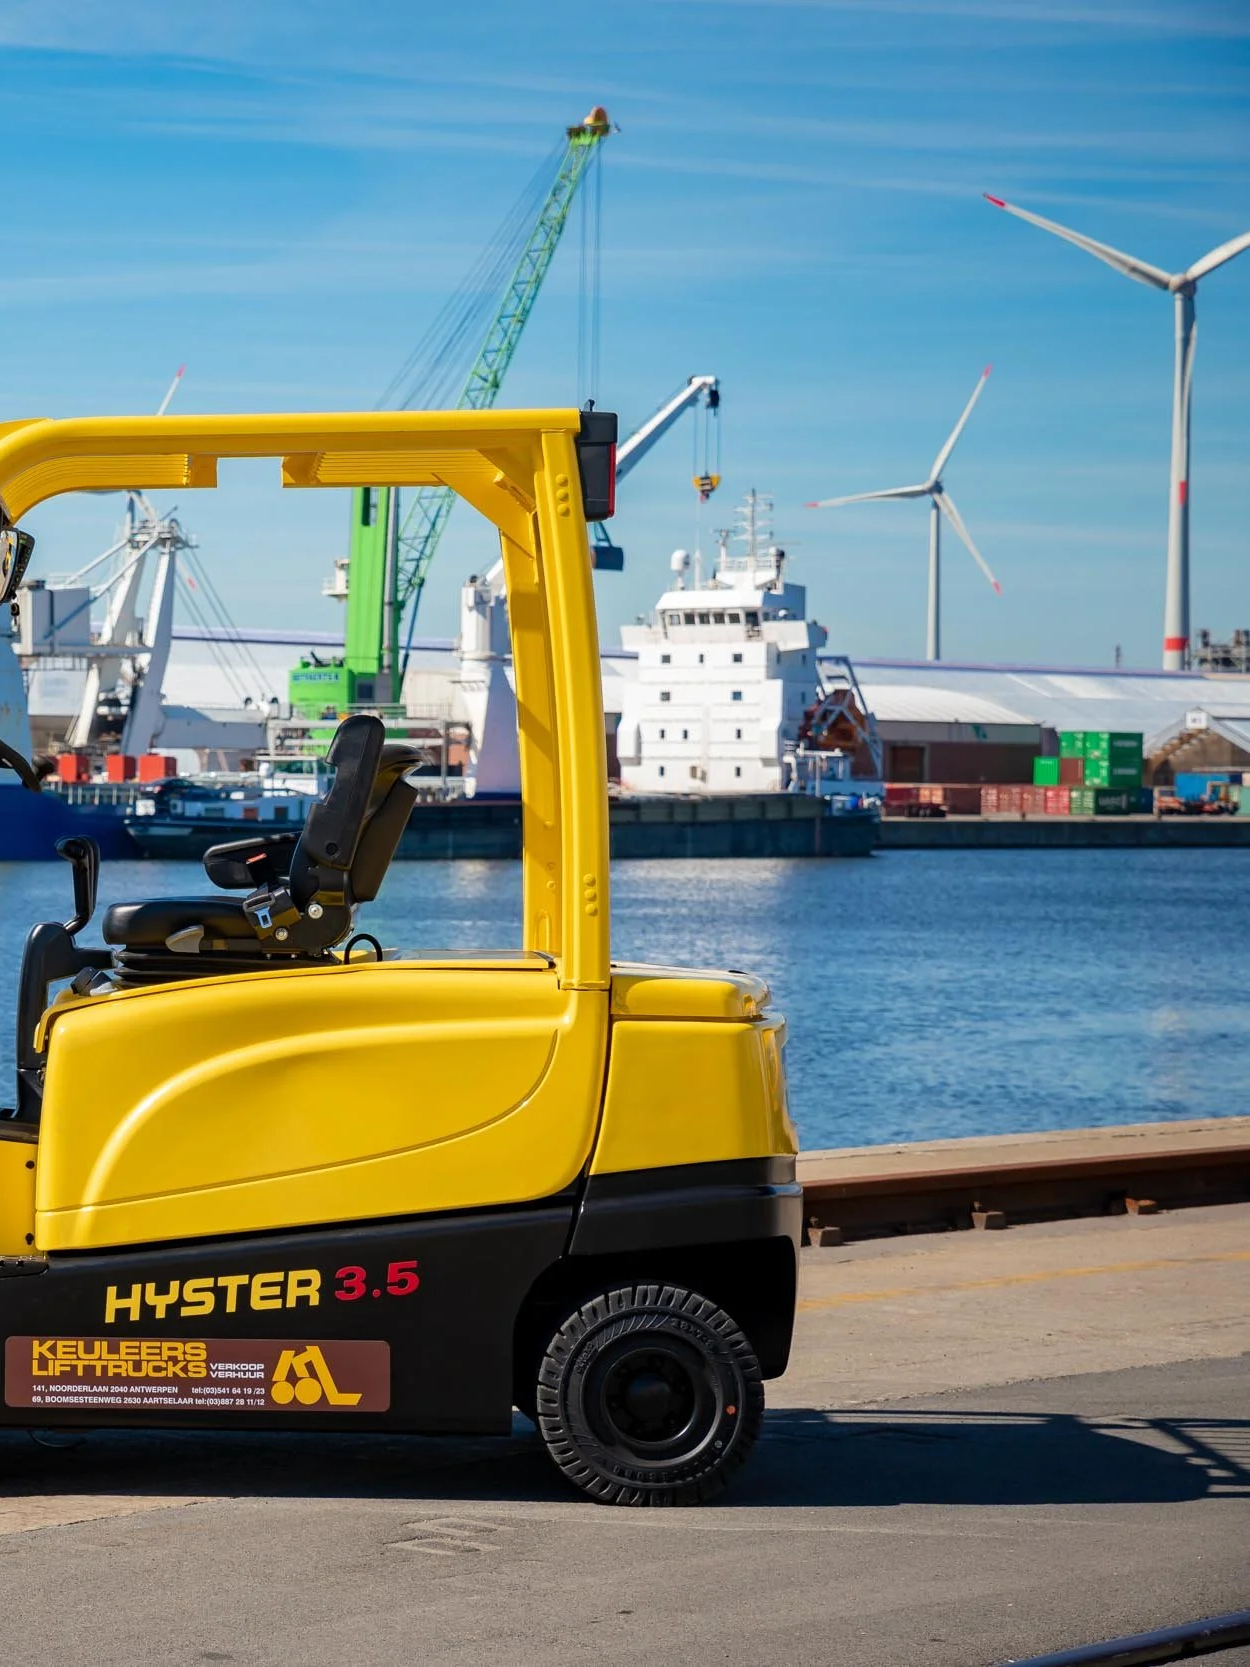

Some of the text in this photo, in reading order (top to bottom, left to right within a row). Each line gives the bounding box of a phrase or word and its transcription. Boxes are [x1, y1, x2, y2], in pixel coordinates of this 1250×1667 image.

[104, 1260, 421, 1324] HYSTER 3.5
[32, 1340, 208, 1361] KEULEERS
[32, 1359, 208, 1378] LIFTTRUCKS
[209, 1362, 265, 1372] VERKOOP
[209, 1371, 265, 1379] VERHUUR
[49, 1385, 109, 1393] NOORDERLAAN
[129, 1386, 179, 1394] ANTWERPEN
[31, 1396, 44, 1404] 69,
[45, 1396, 123, 1405] BOOMSESTEENWEG
[143, 1397, 194, 1406] AARTSELAAR
